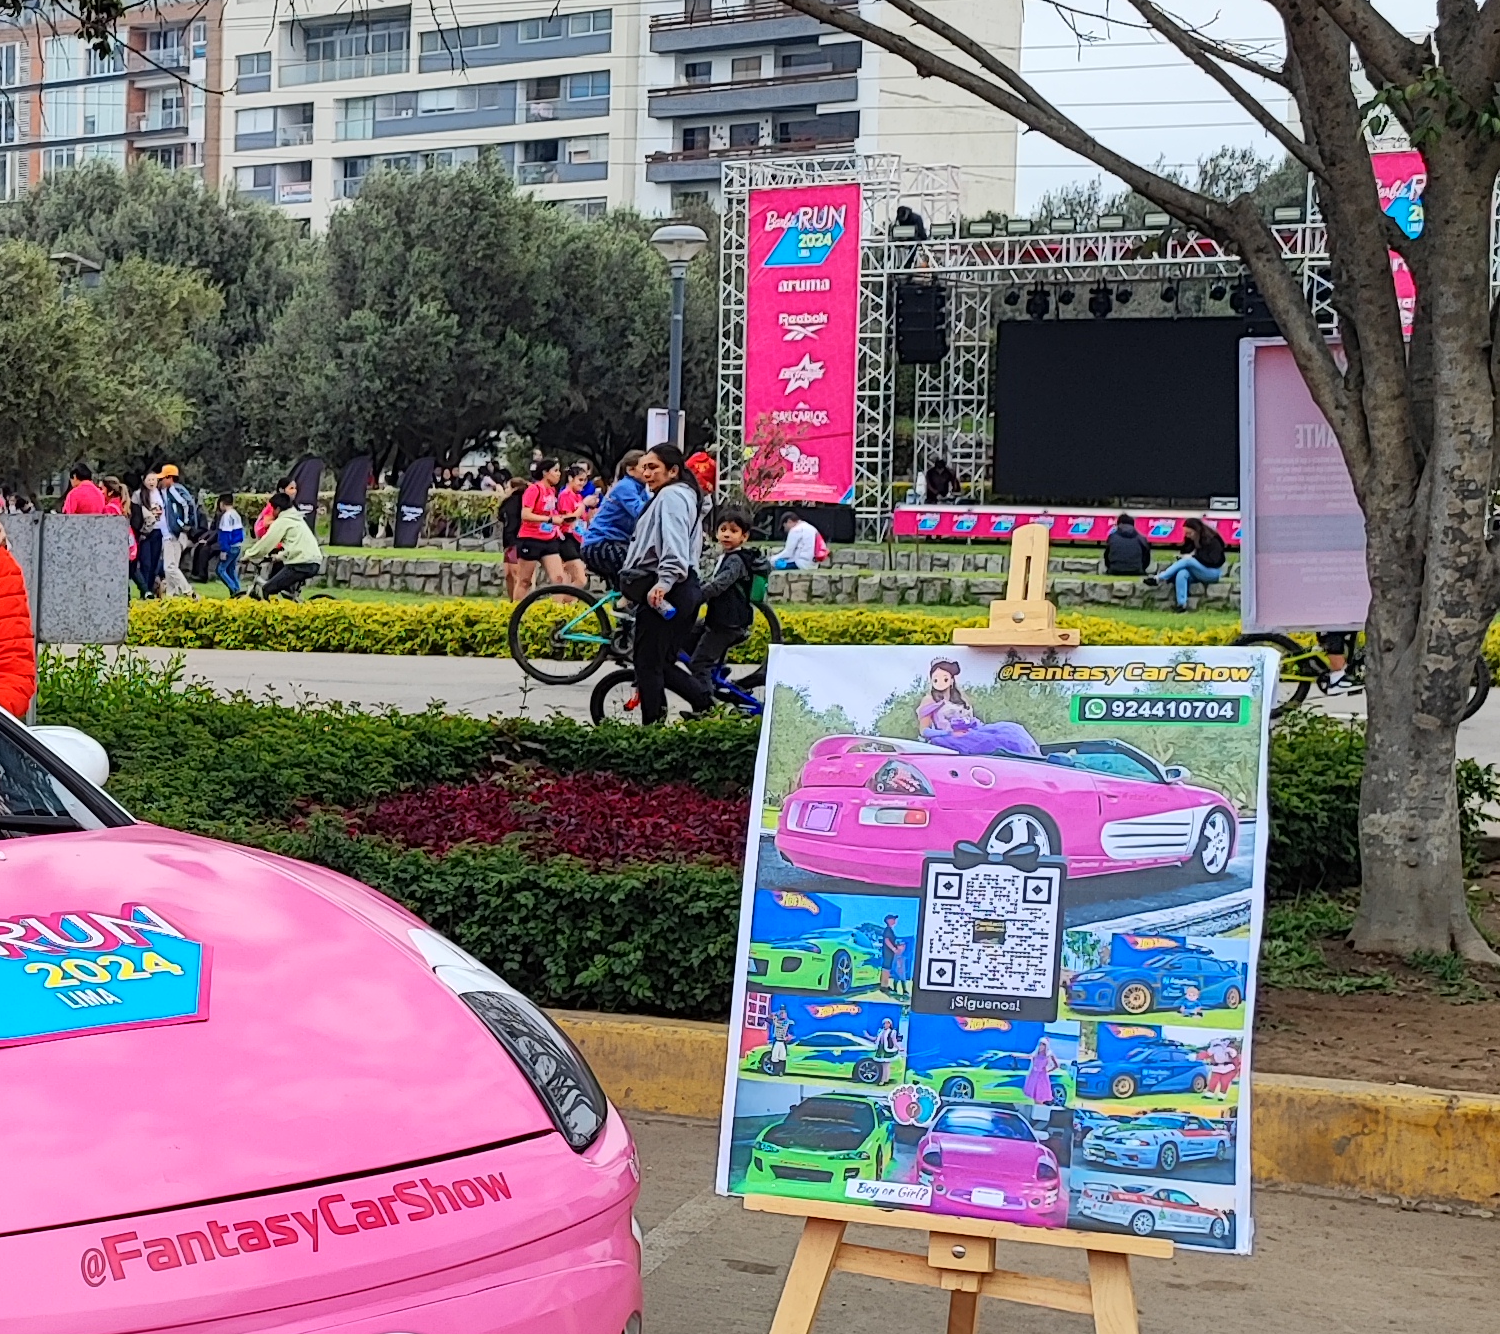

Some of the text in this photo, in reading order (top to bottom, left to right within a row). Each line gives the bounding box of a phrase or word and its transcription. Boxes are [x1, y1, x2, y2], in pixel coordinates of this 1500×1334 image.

[798, 204, 846, 230] RUN
[798, 232, 832, 248] 2024
[778, 278, 830, 292] aruma
[778, 312, 828, 326] Reebok
[999, 663, 1255, 685] @Fantasy Car Show
[1111, 700, 1234, 719] 924410704
[24, 950, 185, 989] 2024
[55, 988, 123, 1009] LIMA
[856, 1183, 929, 1200] Boy or Girl?
[81, 1171, 512, 1288] @FantasyCarShow
